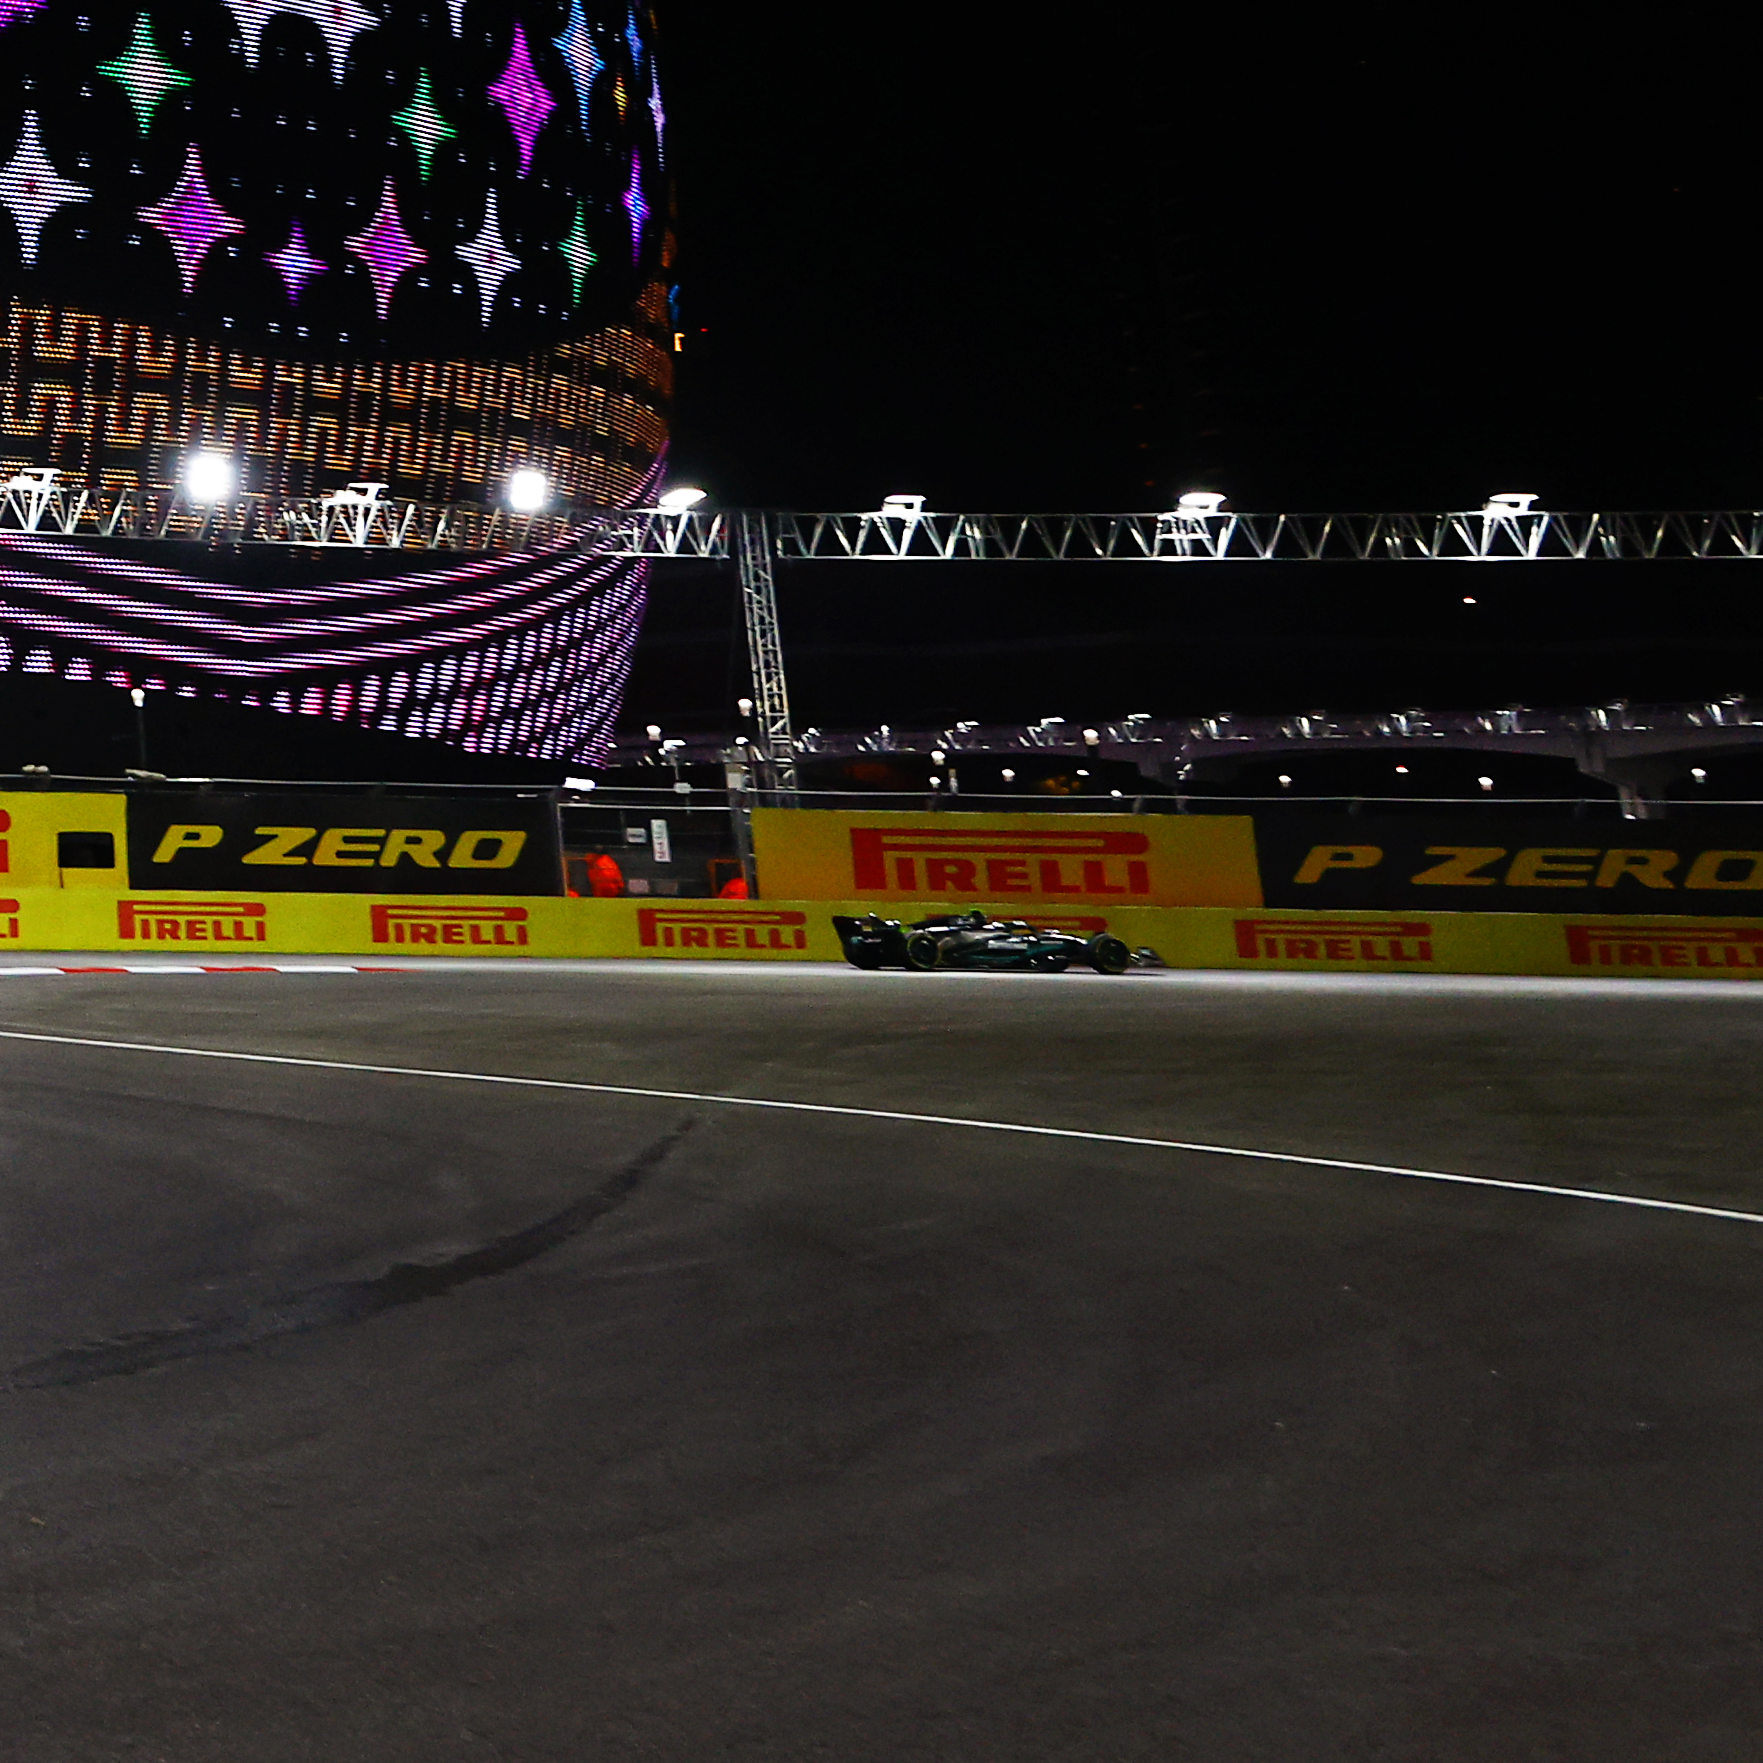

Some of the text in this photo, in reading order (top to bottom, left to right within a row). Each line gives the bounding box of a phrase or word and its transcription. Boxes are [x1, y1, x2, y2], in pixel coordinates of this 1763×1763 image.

[153, 824, 526, 868] P ZERO
[850, 827, 1150, 894] PIRELLI
[1293, 845, 1383, 884] P
[118, 900, 267, 941] PIRELLI
[371, 904, 529, 946] PIRELLI
[638, 908, 807, 950] PIRELLI
[1234, 920, 1433, 961] PIRELLI
